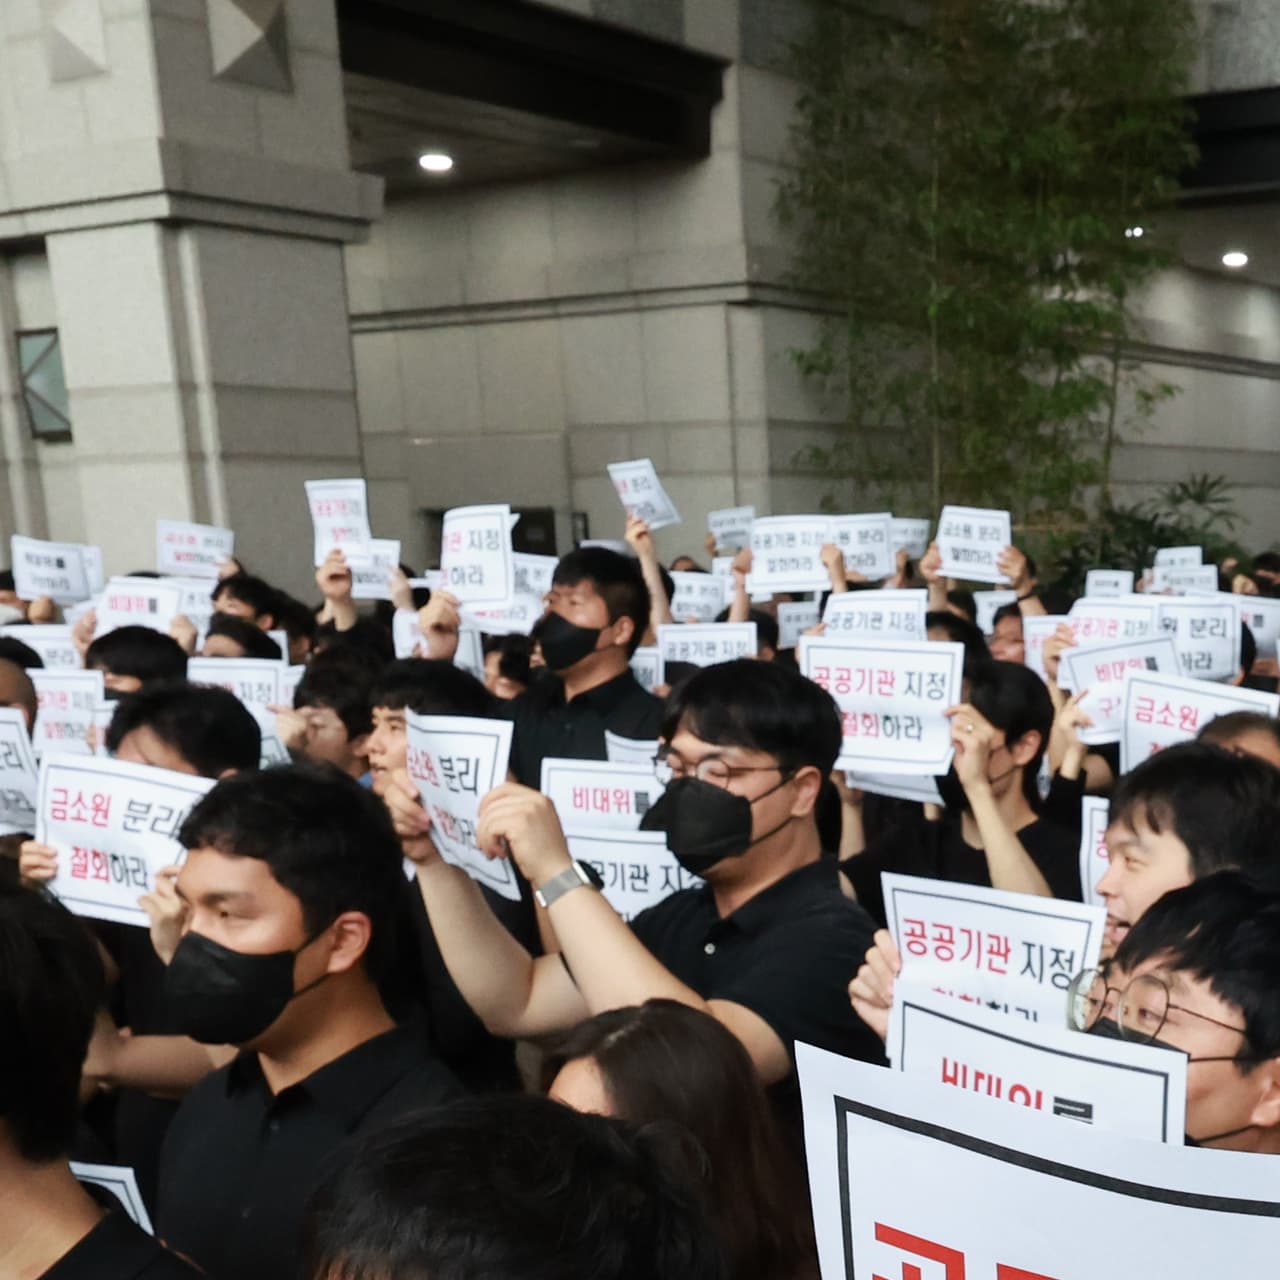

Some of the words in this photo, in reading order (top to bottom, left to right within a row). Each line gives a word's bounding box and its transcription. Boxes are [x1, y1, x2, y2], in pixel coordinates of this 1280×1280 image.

[468, 529, 500, 551] 지정
[1189, 617, 1227, 640] 분리
[812, 665, 896, 699] 공공기관
[903, 670, 947, 702] 지정
[841, 710, 923, 742] 철회하라
[1135, 695, 1200, 732] 금소원
[439, 756, 480, 797] 분리
[50, 787, 112, 828] 금소원
[120, 798, 182, 841] 분리
[571, 786, 651, 815] 비대위를
[68, 846, 150, 889] 철회하라
[903, 917, 1012, 975] 공공기관
[1020, 940, 1075, 992] 지정
